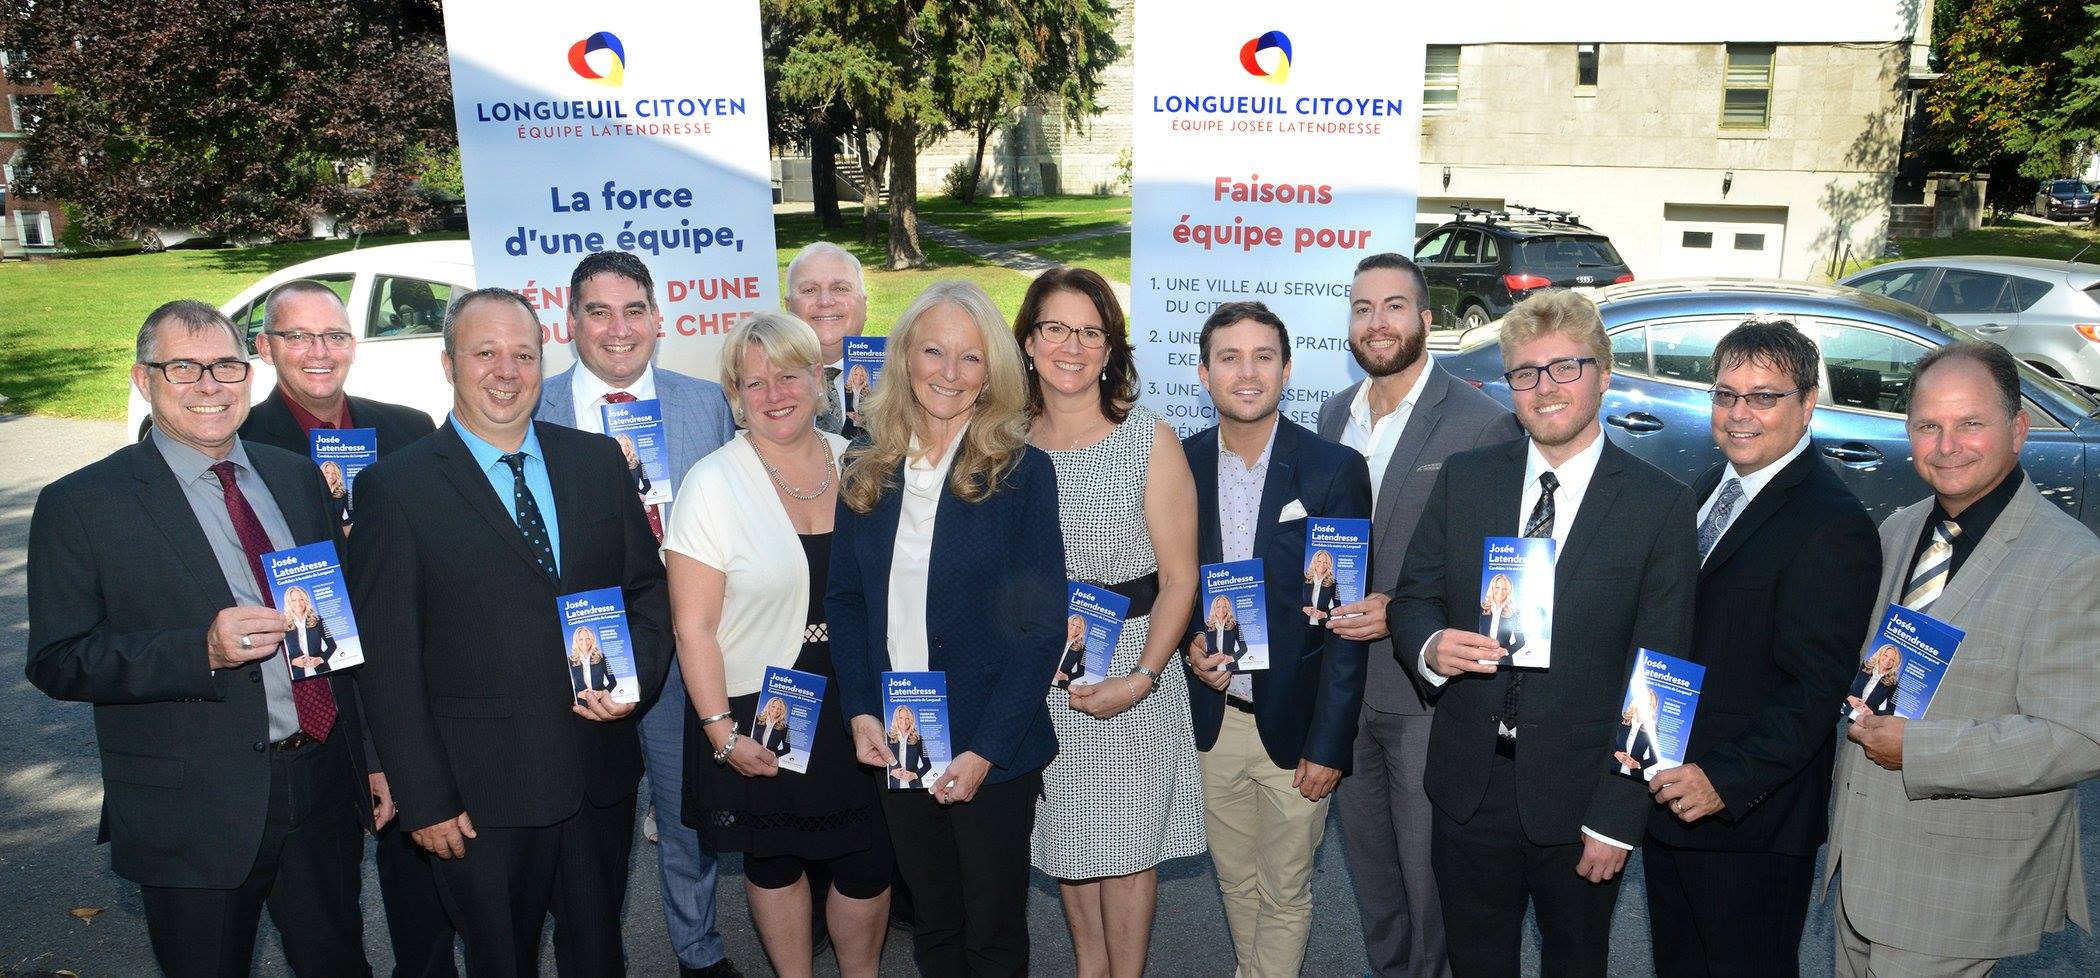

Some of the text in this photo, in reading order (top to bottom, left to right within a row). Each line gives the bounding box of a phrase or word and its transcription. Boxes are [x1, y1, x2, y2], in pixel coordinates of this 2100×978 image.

[477, 97, 746, 122] LONGUEUIL CITOYEN
[1153, 95, 1403, 117] LONGUEUIL CITOYEN
[518, 122, 712, 139] ÉQUIPE LATENDRESSE
[1172, 117, 1382, 135] ÉQUIPE JOSÉE LATENDRESSE
[1214, 173, 1333, 205] Faisons
[550, 180, 693, 213] La force
[505, 218, 744, 257] d'une équipe,
[1172, 214, 1372, 253] équipe pour
[667, 276, 760, 303] D'UNE
[1150, 278, 1161, 290] 1.
[1166, 278, 1200, 291] UNE
[1206, 279, 1250, 293] VILLE
[1255, 281, 1277, 294] AU
[1166, 300, 1189, 313] DU
[1149, 330, 1162, 343] 2.
[1168, 331, 1200, 344] UNE
[848, 341, 868, 349] Josée
[1147, 382, 1160, 395] 3.
[1166, 383, 1200, 396] UNE
[1165, 405, 1217, 418] SOUCI
[316, 435, 340, 443] Josée
[316, 443, 366, 451] Latendresse
[1312, 523, 1335, 533] Josée
[1312, 532, 1358, 542] Latendresse
[1488, 543, 1514, 553] Josée
[271, 555, 298, 569] Josée
[272, 559, 328, 578] Latendresse
[1206, 569, 1229, 579] Josée
[1207, 575, 1254, 587] Latendresse
[1072, 588, 1096, 602] Josée
[564, 598, 589, 611] Josée
[565, 604, 615, 619] Latendresse
[1070, 595, 1116, 617] Latendresse
[1890, 613, 1917, 633] Josée
[1886, 621, 1940, 656] Latendresse
[770, 673, 792, 684] Josée
[888, 678, 912, 687] Josée
[1644, 668, 1691, 687] atendresse
[769, 680, 815, 697] Latendresse
[889, 687, 937, 696] Latendresse
